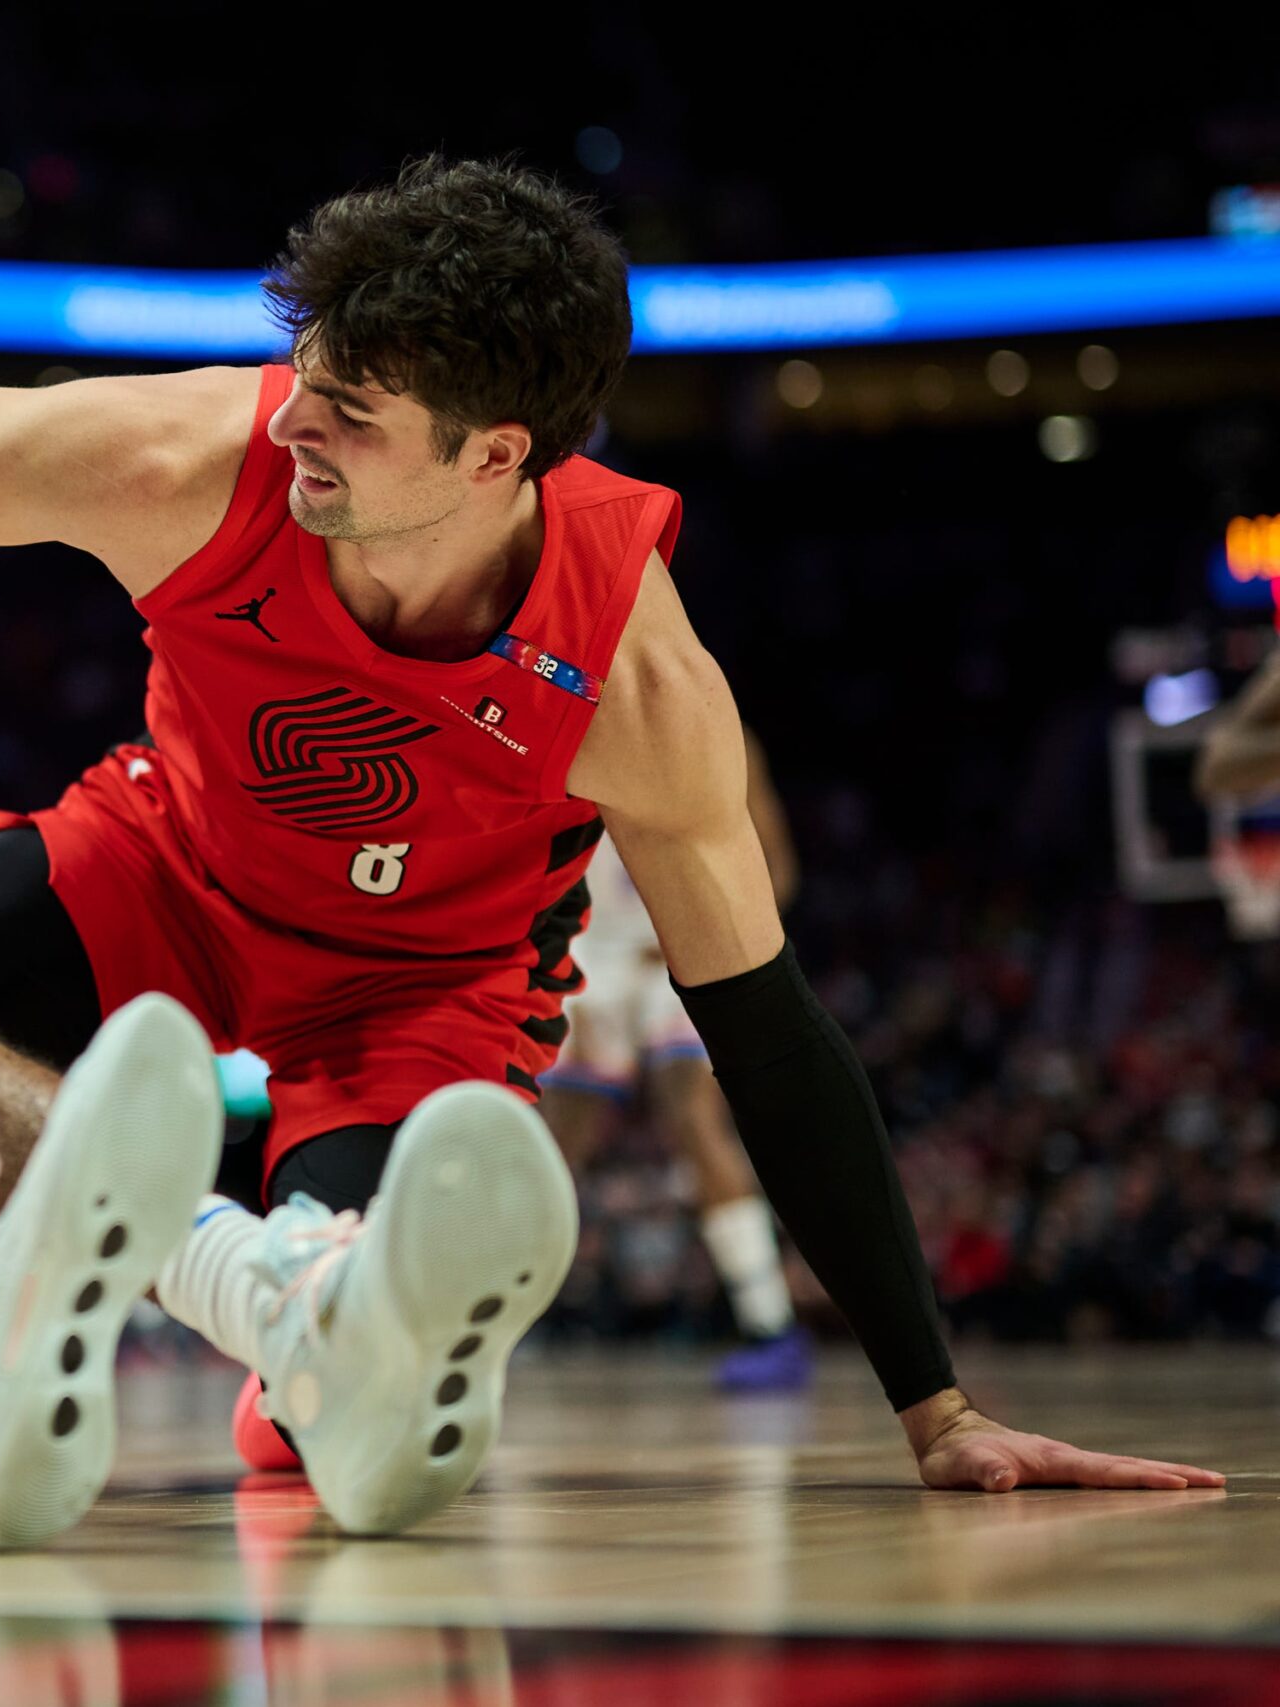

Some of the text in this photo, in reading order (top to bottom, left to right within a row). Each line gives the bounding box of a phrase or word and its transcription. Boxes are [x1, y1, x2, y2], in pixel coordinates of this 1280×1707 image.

[532, 653, 559, 680] 32
[440, 695, 529, 756] GHTSIDE
[483, 703, 503, 724] B
[349, 842, 411, 896] 8
